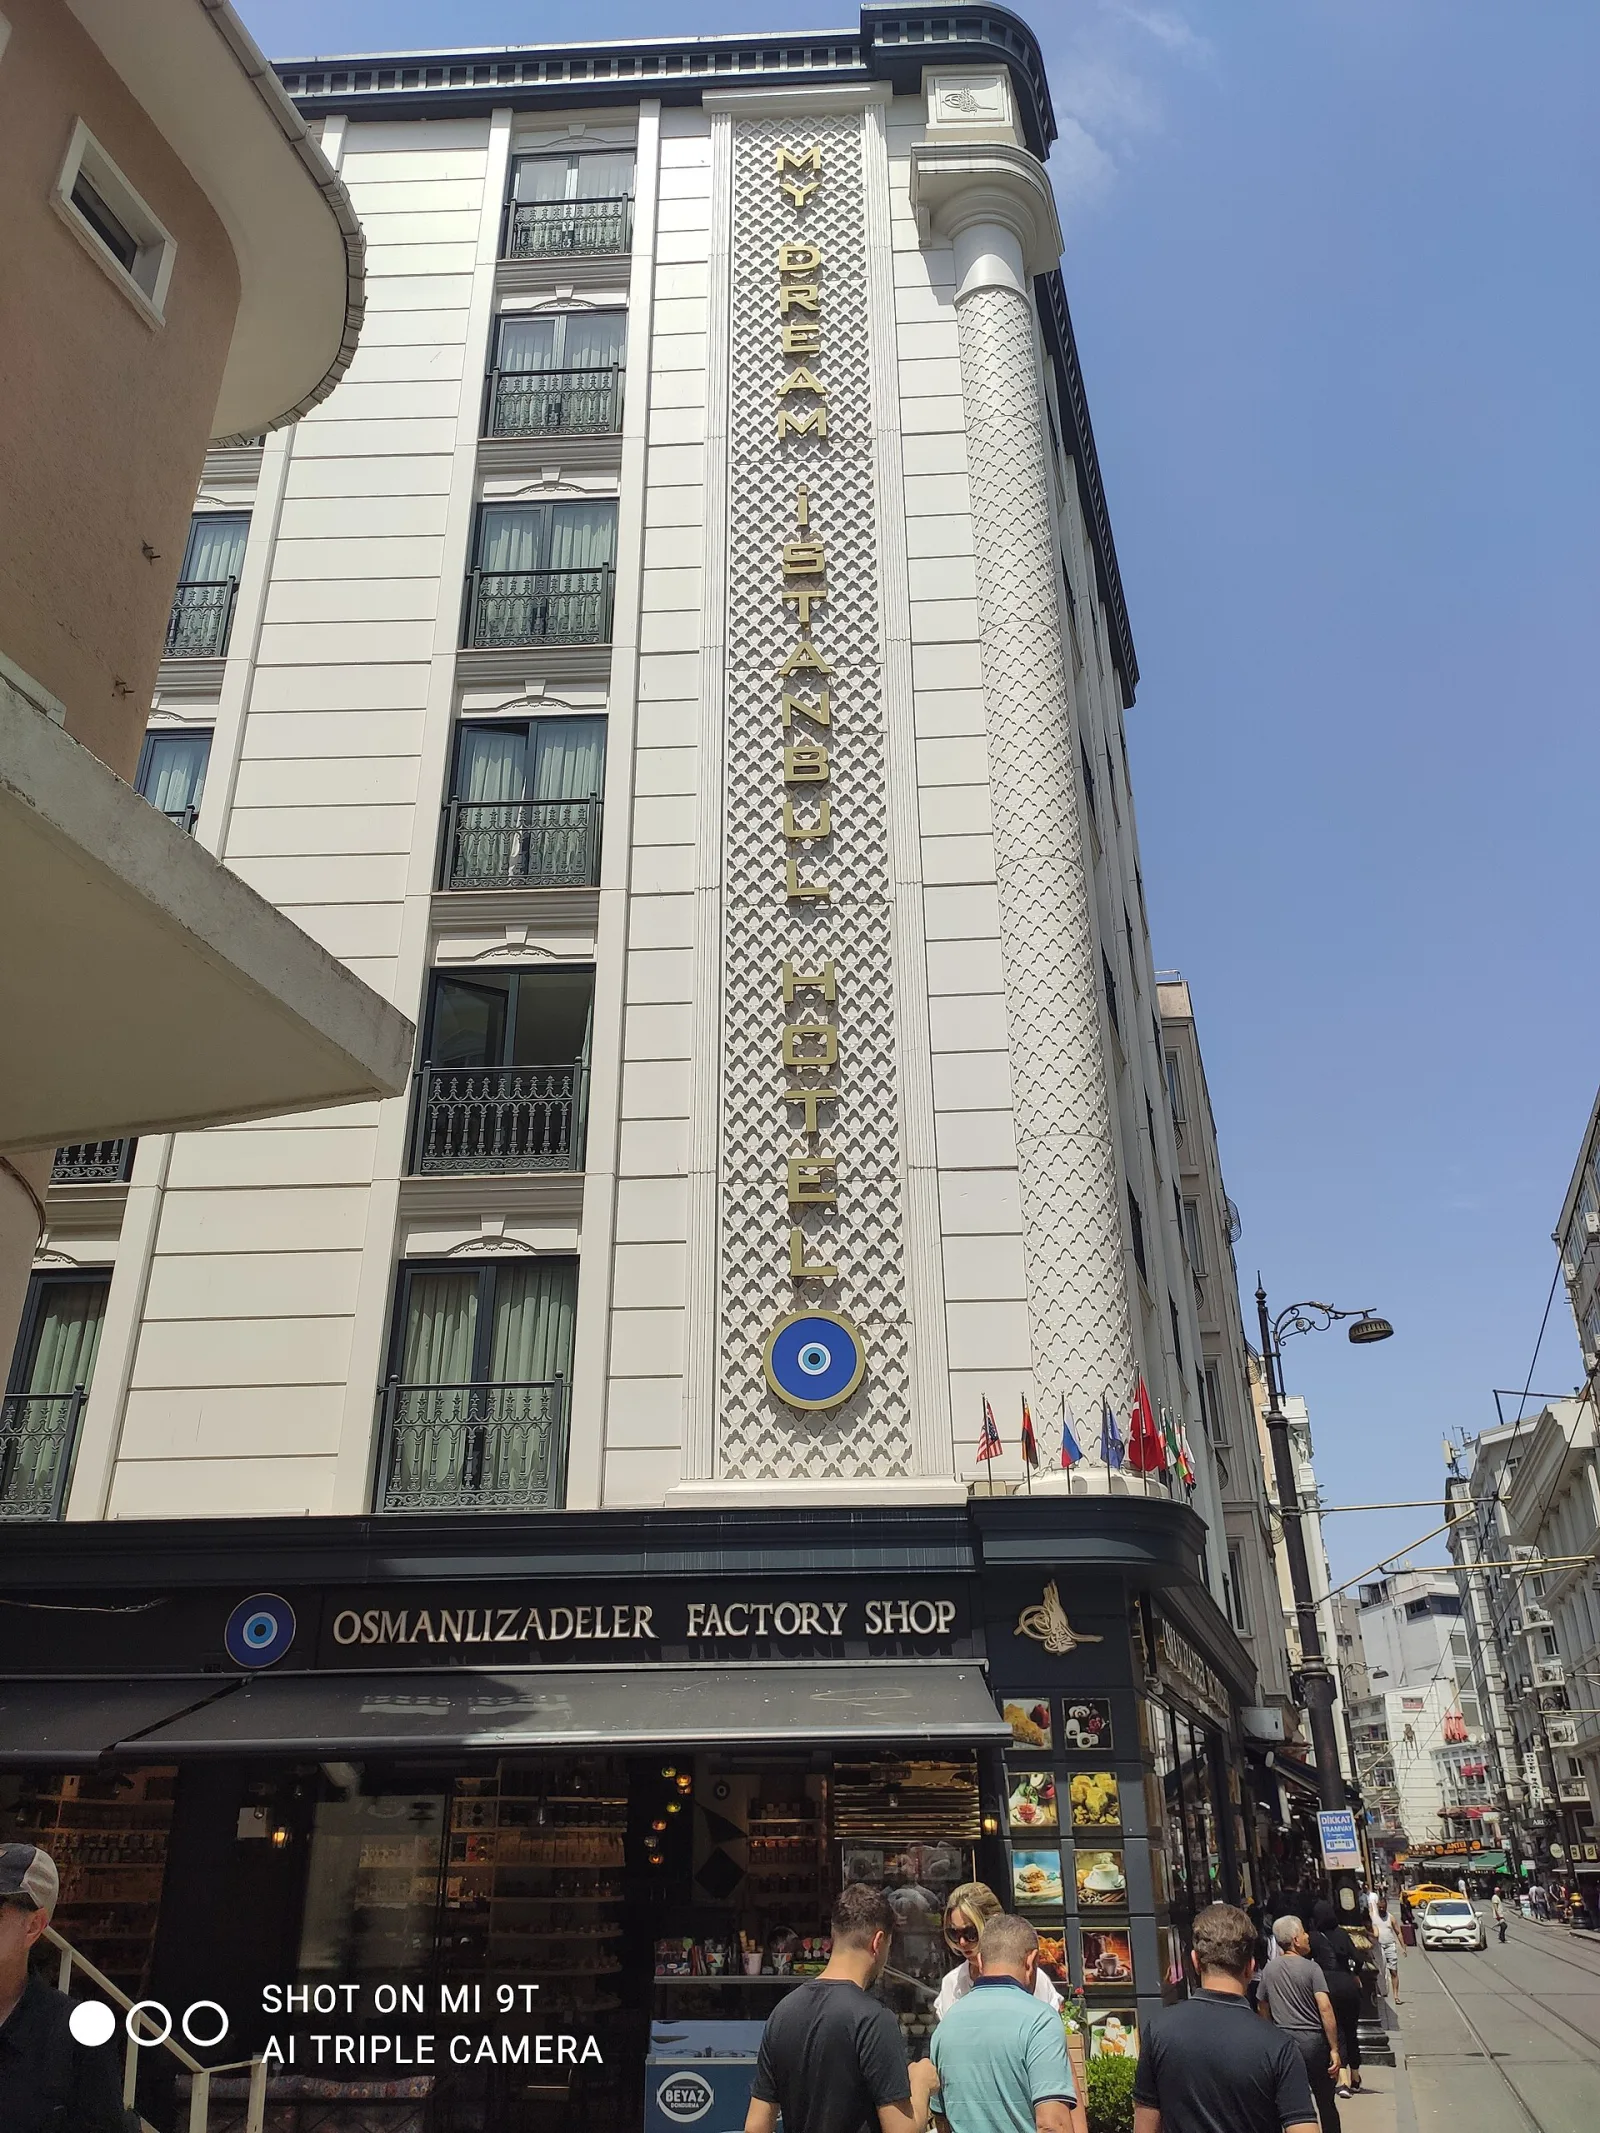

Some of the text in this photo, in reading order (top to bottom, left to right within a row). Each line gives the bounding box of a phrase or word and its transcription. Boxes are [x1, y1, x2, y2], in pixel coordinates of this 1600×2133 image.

[776, 146, 822, 206] MY
[777, 245, 827, 438] DREAM
[782, 961, 838, 1277] HOTEL
[333, 1600, 956, 1644] OSMANLIZADELER FACTORY SHOP
[1321, 1815, 1351, 1825] DİKKAT
[1322, 1825, 1352, 1833] TRAMVAY
[665, 2089, 705, 2102] BEYAZ
